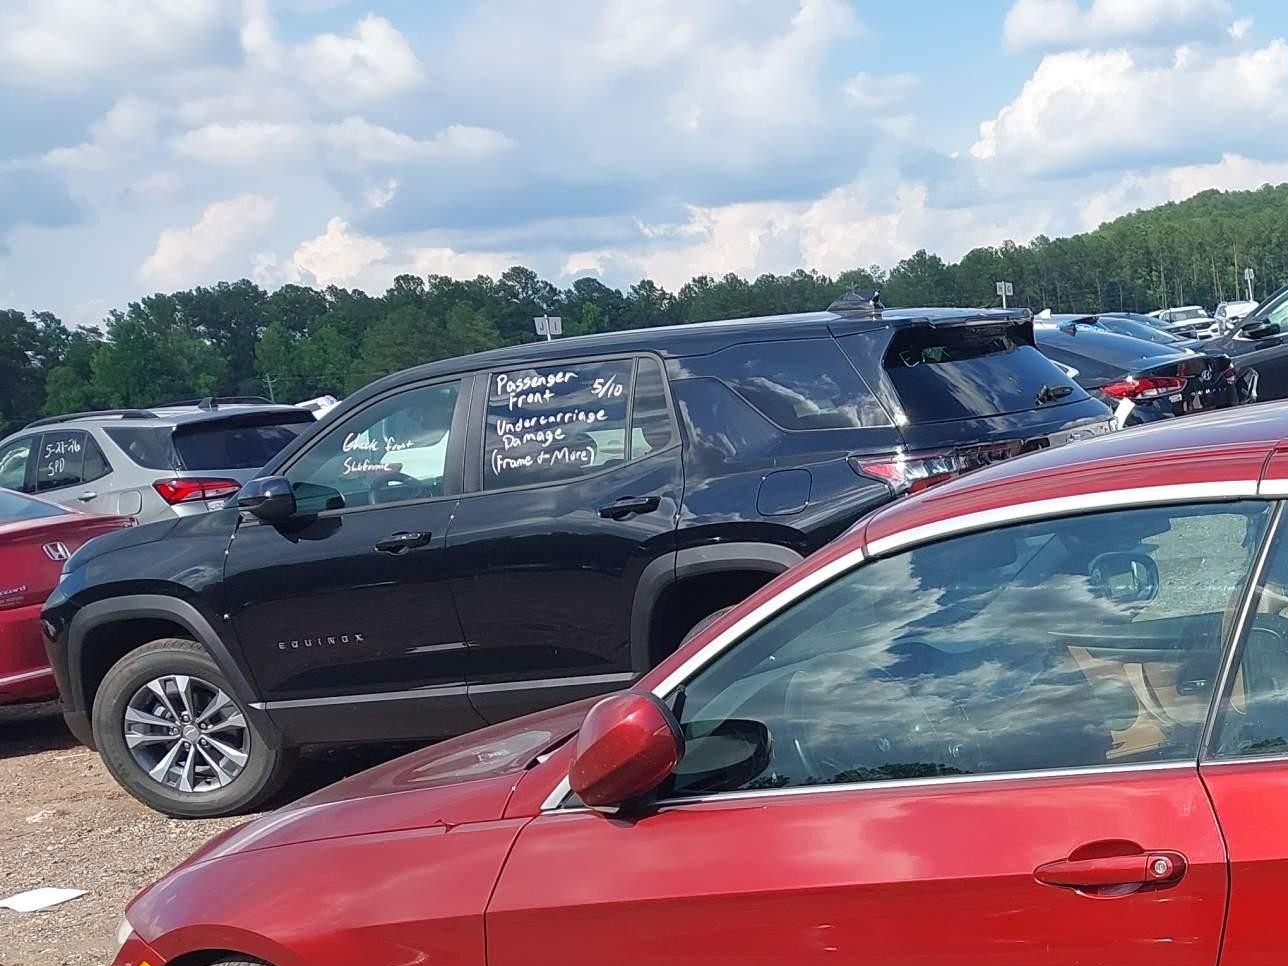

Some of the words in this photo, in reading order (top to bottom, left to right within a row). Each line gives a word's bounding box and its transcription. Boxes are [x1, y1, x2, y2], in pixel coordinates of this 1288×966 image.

[496, 371, 578, 395] Passenger
[590, 374, 623, 398] 5/10
[509, 392, 554, 411] Front
[496, 409, 608, 436] Undercarriage
[502, 428, 566, 450] Damage
[491, 449, 533, 476] (Frame
[550, 446, 595, 466] More)
[278, 633, 364, 650] EQUINOX
